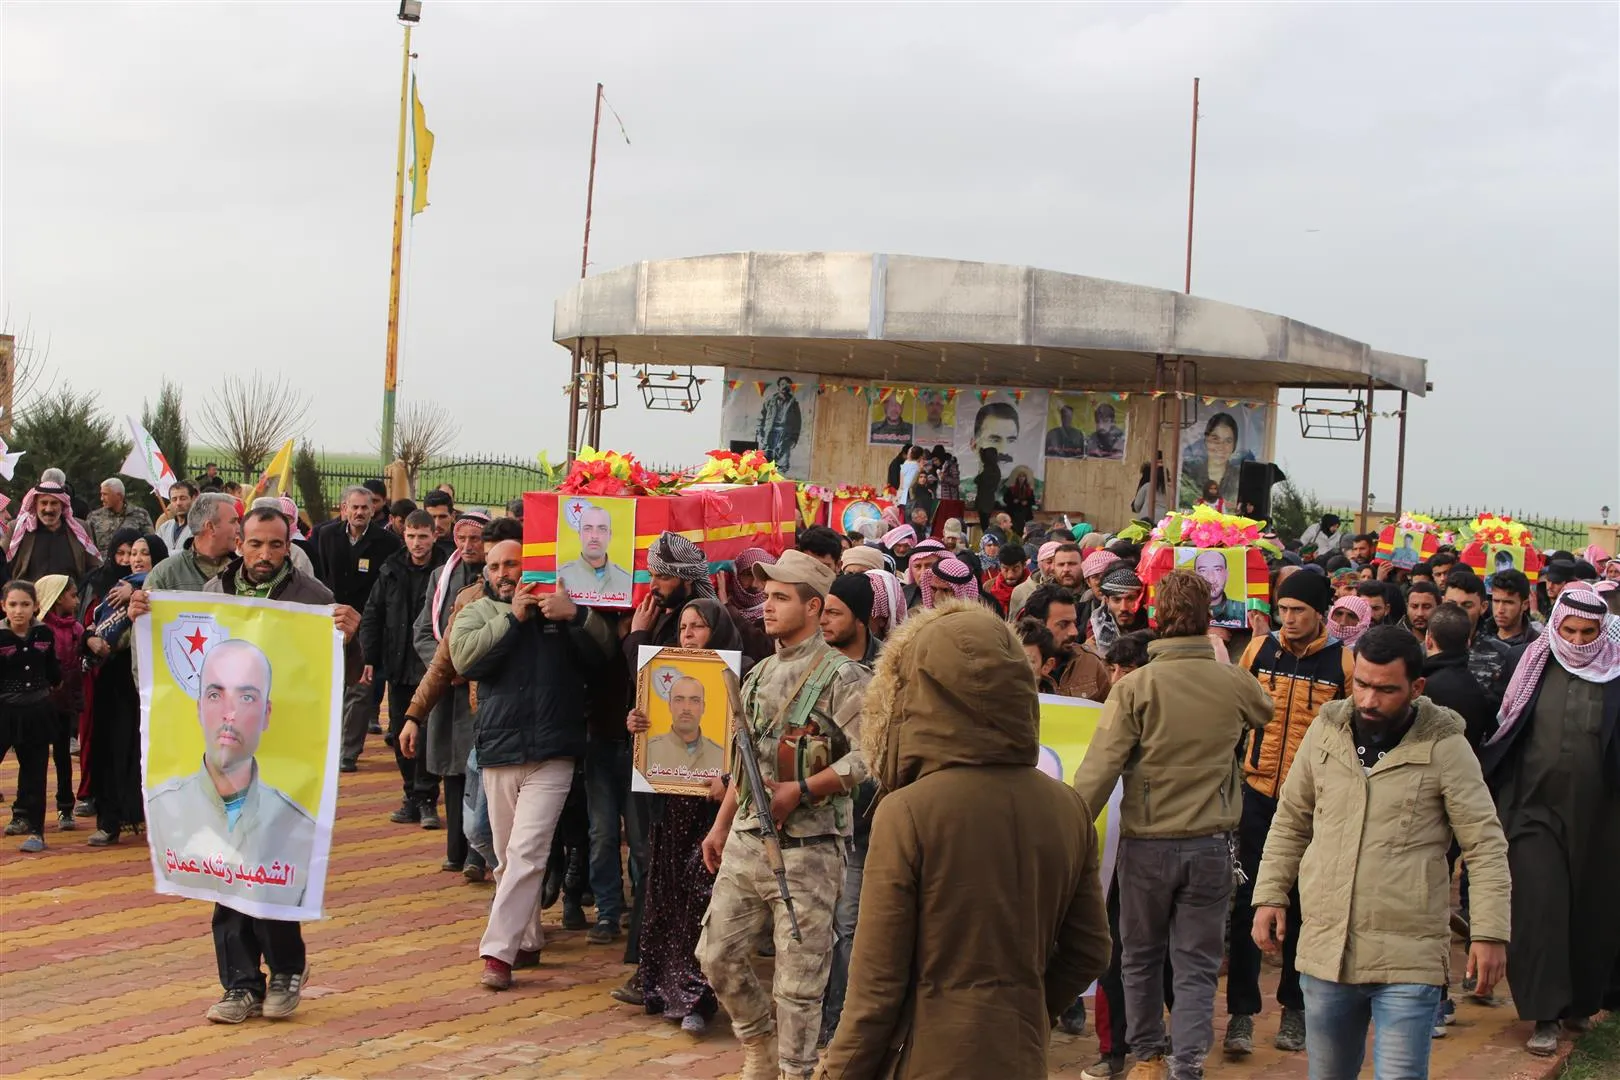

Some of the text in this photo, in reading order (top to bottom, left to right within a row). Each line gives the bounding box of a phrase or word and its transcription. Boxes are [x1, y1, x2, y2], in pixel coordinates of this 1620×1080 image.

[646, 761, 672, 778] عماش
[203, 853, 233, 884] رشاد
[235, 860, 296, 887] الشهيد
